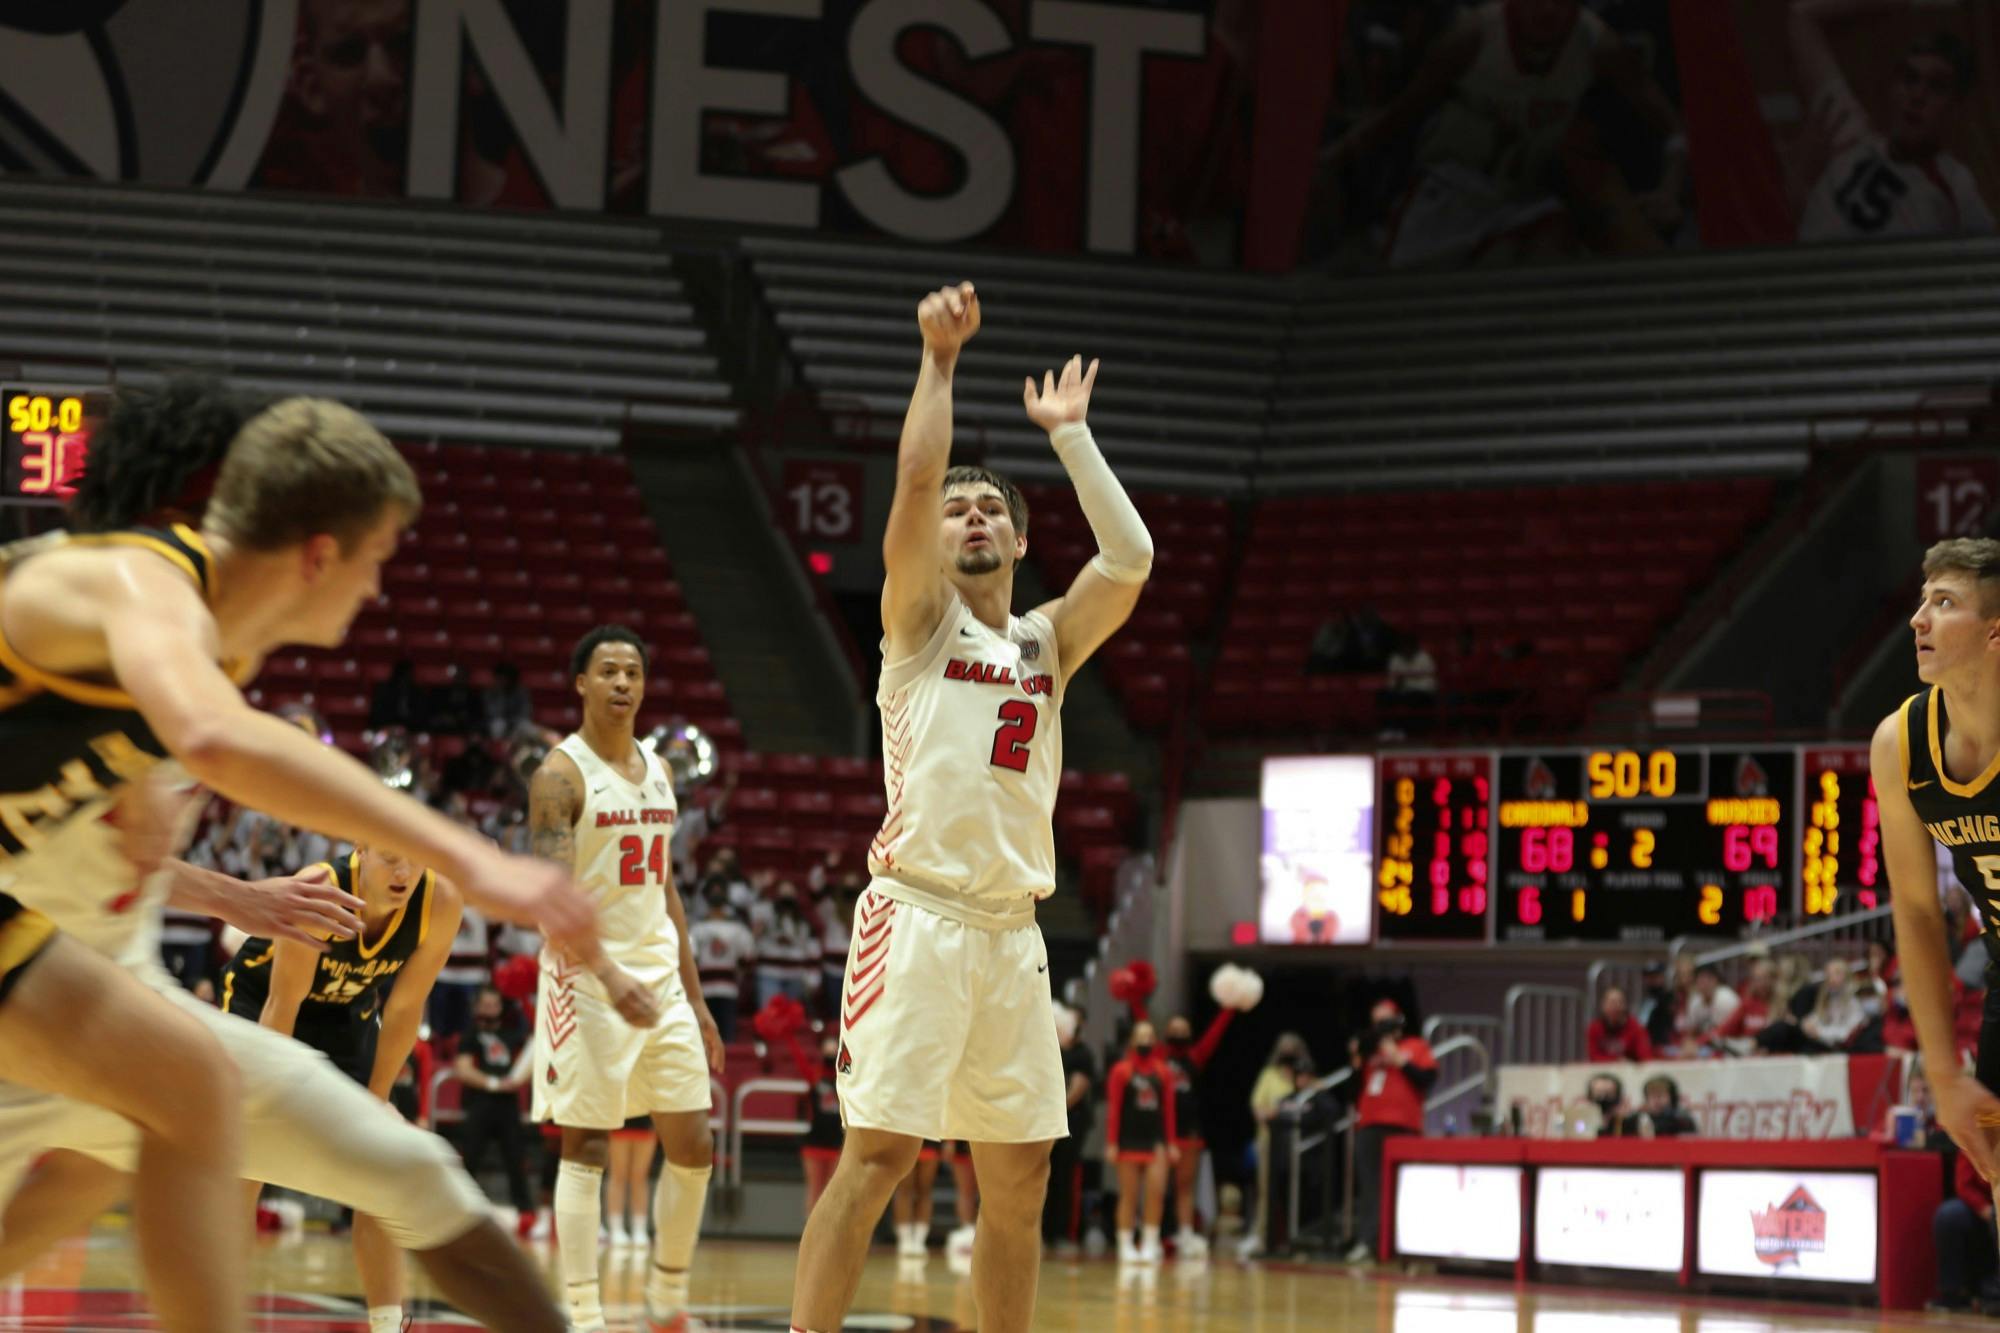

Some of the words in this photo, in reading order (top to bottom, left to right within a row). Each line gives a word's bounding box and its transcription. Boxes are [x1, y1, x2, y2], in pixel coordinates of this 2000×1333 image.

[404, 0, 1206, 255] NEST
[8, 394, 83, 434] 50.0
[788, 483, 852, 537] 13
[1923, 481, 1986, 537] 12
[943, 658, 1017, 686] BALL
[990, 698, 1038, 774] 2
[1587, 750, 1677, 799] 50.0
[595, 809, 638, 829] BALL
[619, 834, 664, 886] 24
[1520, 826, 1574, 874] 68
[1631, 827, 1656, 869] 2
[1723, 824, 1779, 872] 69
[1698, 883, 1724, 925] 2
